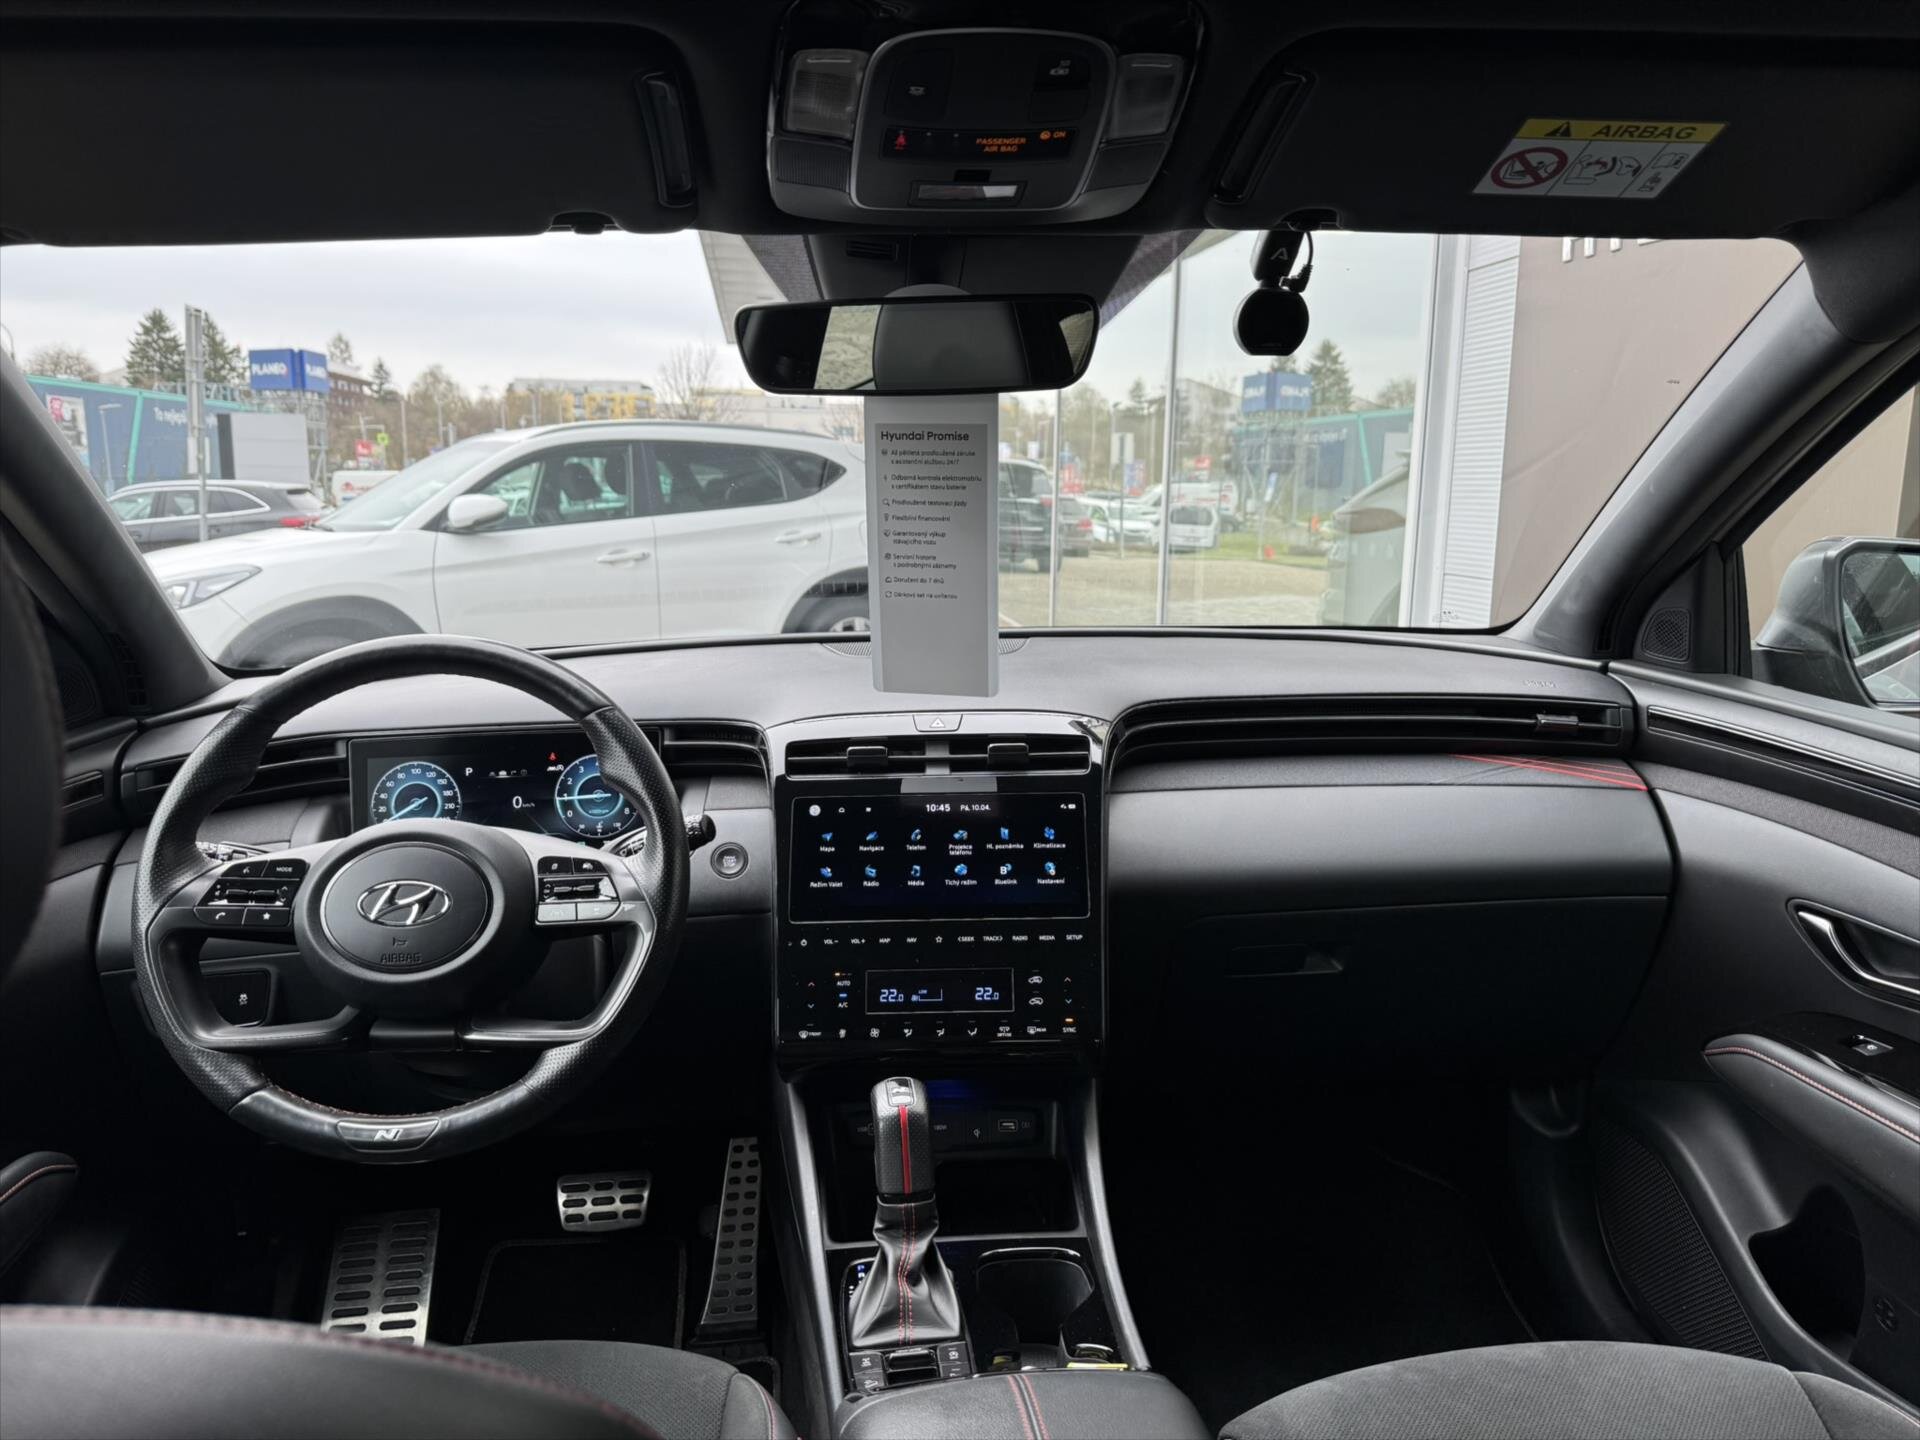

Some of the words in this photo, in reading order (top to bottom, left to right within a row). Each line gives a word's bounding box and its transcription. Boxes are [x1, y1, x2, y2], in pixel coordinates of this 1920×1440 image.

[1591, 125, 1698, 139] AIRBAG
[976, 137, 1027, 145] PASSENGER
[881, 431, 925, 442] Hyundai
[927, 431, 969, 441] Promise
[465, 767, 473, 776] P
[513, 796, 522, 809] 0
[926, 804, 951, 812] 10:45
[945, 879, 960, 887] Tichý
[380, 952, 422, 964] AIRBAG
[879, 988, 905, 1002] 22.0
[975, 987, 1000, 1000] 22.0
